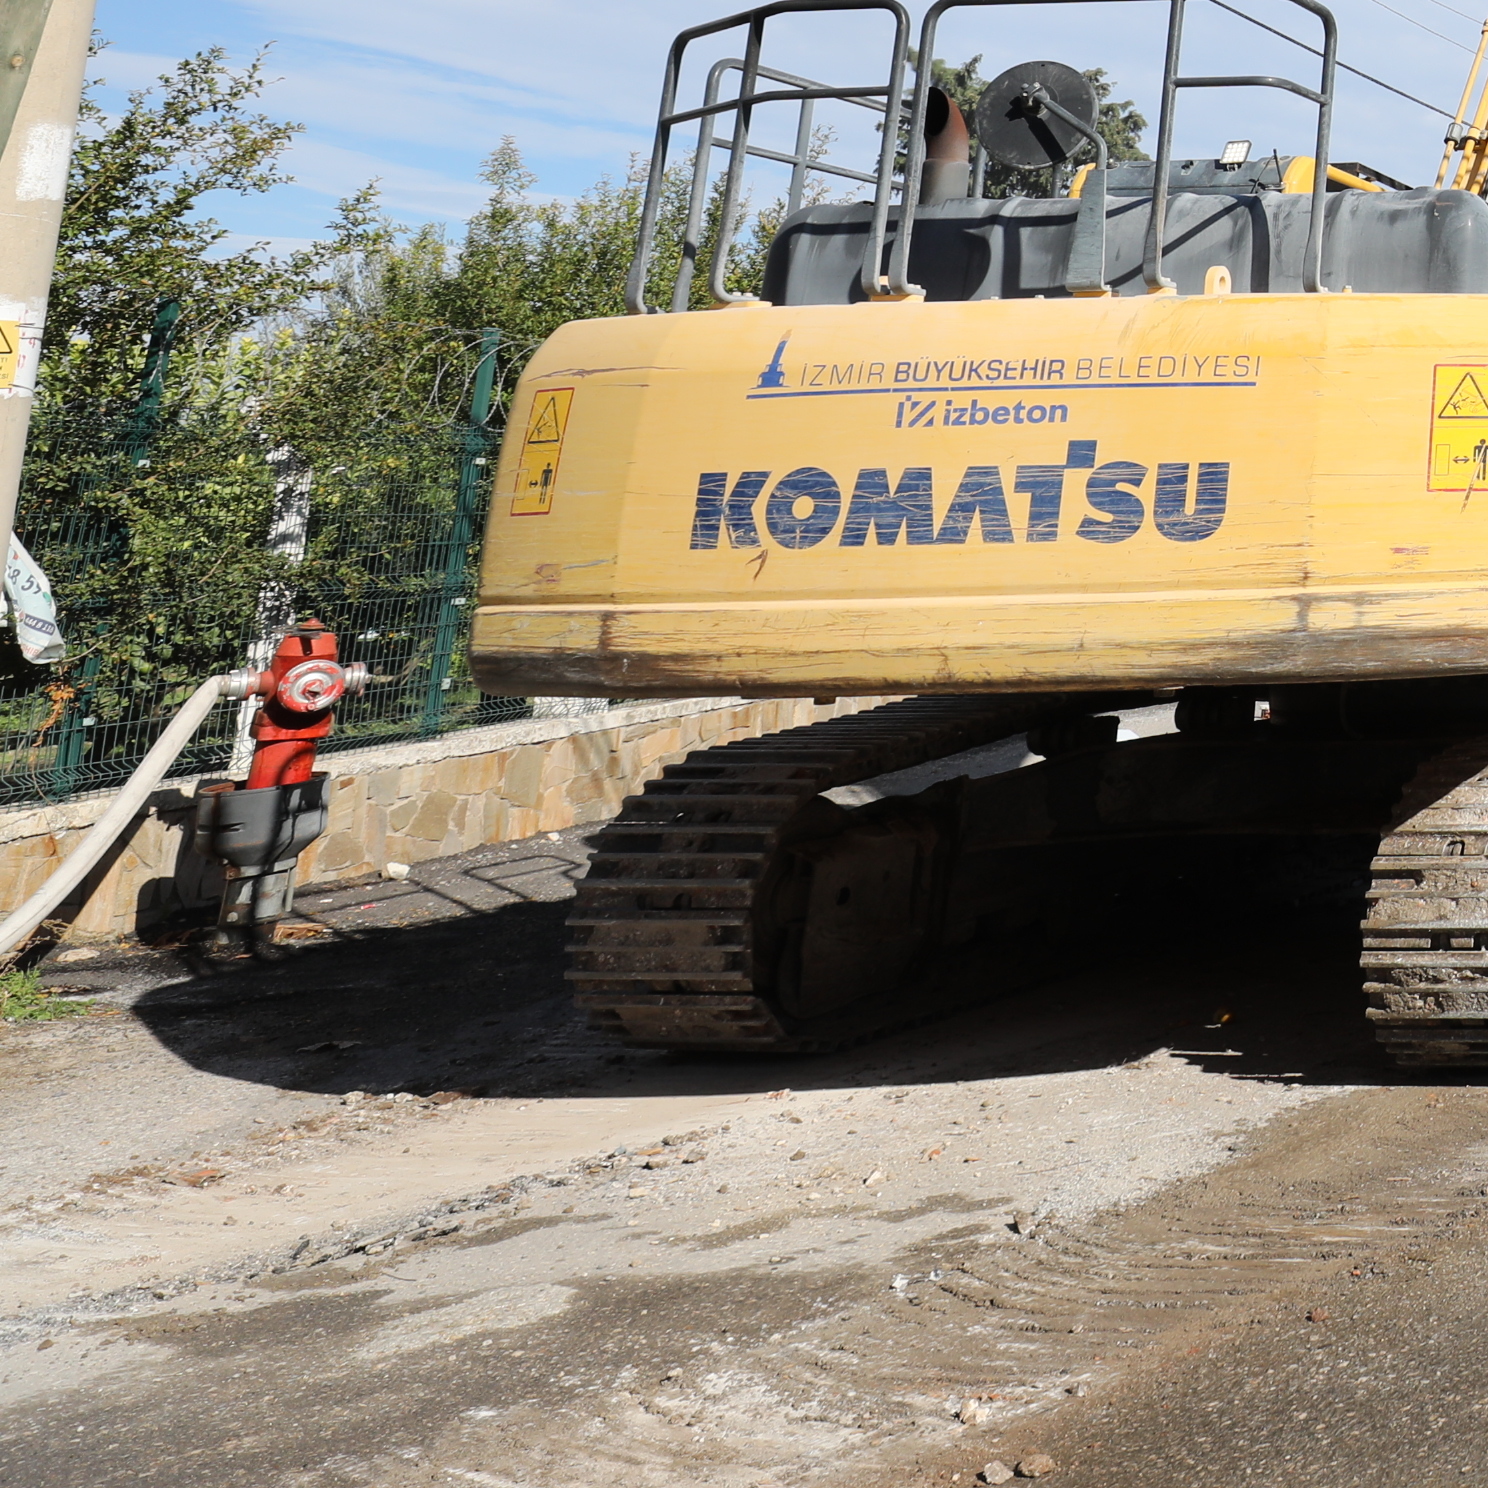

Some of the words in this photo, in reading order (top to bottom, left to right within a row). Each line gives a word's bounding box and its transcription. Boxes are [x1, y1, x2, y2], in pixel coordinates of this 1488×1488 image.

[800, 360, 886, 387] İZMİR
[893, 355, 1066, 384] BÜYÜKŞEHİR
[942, 398, 1069, 427] izbeton
[689, 439, 1231, 551] KOMATSU
